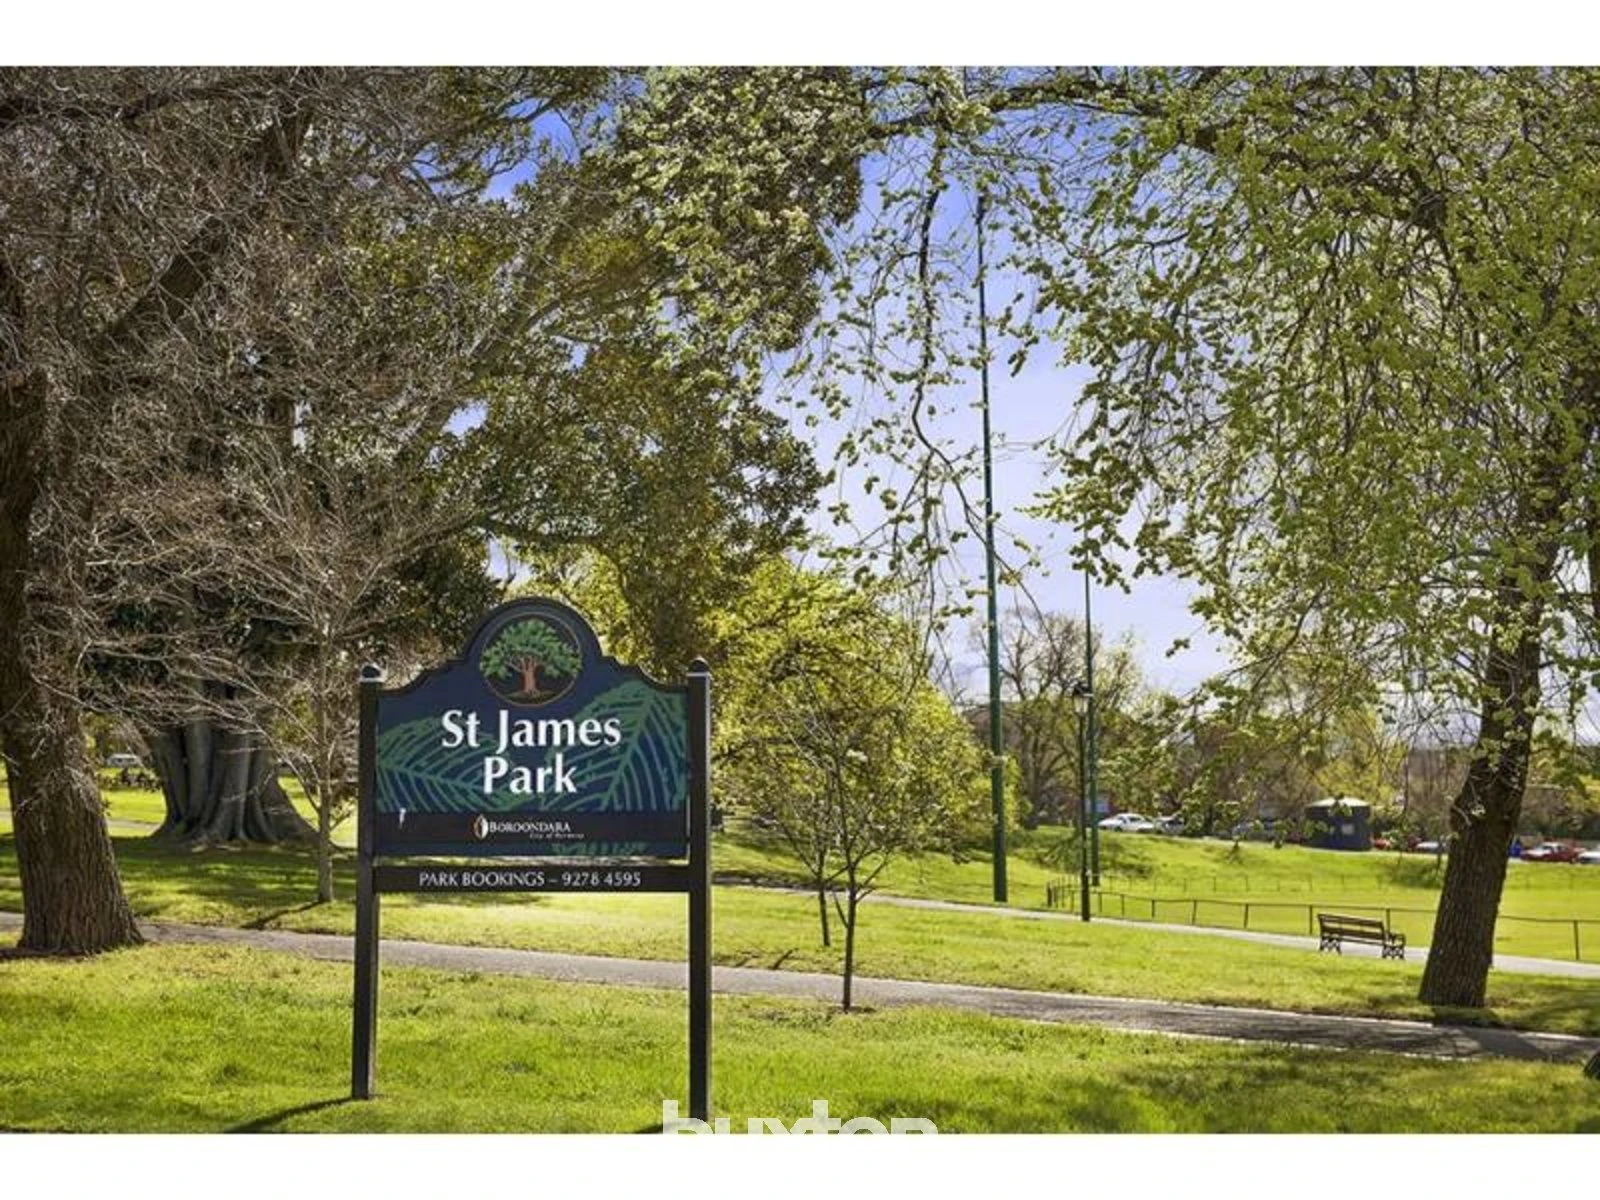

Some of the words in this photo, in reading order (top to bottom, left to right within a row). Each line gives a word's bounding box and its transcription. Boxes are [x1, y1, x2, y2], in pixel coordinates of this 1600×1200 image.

[441, 710, 481, 748] St
[496, 709, 622, 755] James
[482, 753, 577, 795] Park
[489, 821, 571, 833] BOROONDARA
[418, 873, 459, 887] PARK
[462, 872, 546, 888] BOOKINGS
[561, 872, 599, 888] 9278
[604, 872, 641, 888] 4595
